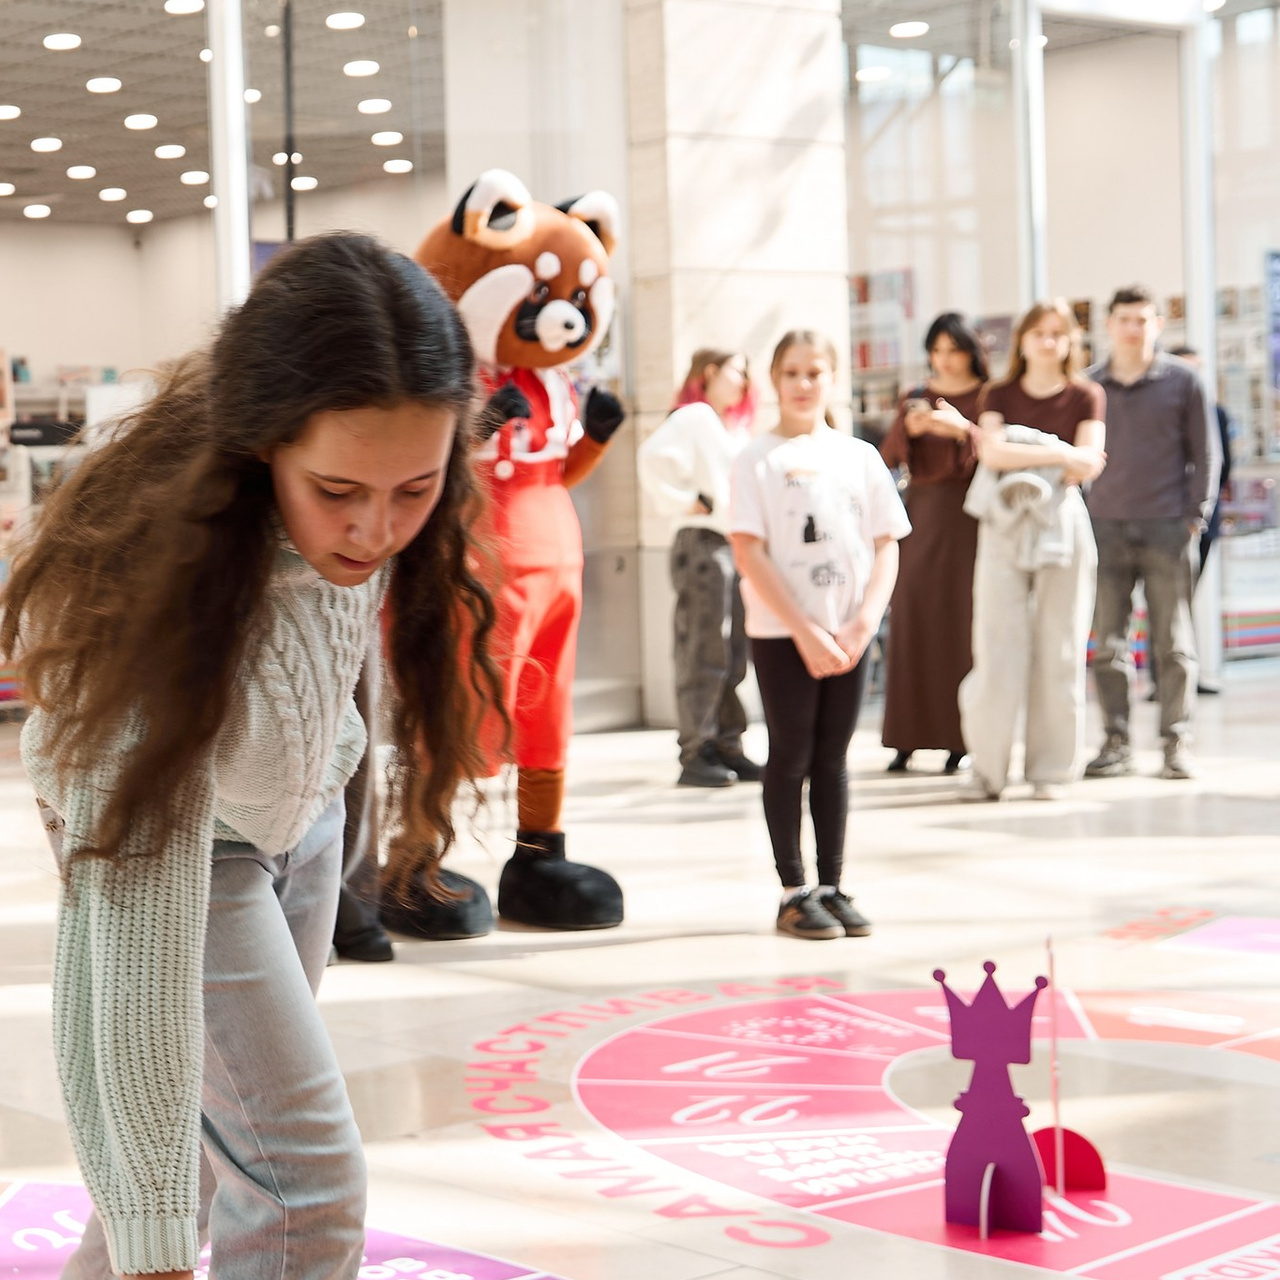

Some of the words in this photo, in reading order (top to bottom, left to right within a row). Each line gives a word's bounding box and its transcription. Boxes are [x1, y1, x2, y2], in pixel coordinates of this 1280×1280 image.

[463, 975, 846, 1115] СЧАСТЛИВАЯ
[670, 1095, 812, 1126] 22
[479, 1122, 832, 1250] САМАЯ
[791, 1157, 946, 1197] ДЕЛАЙ
